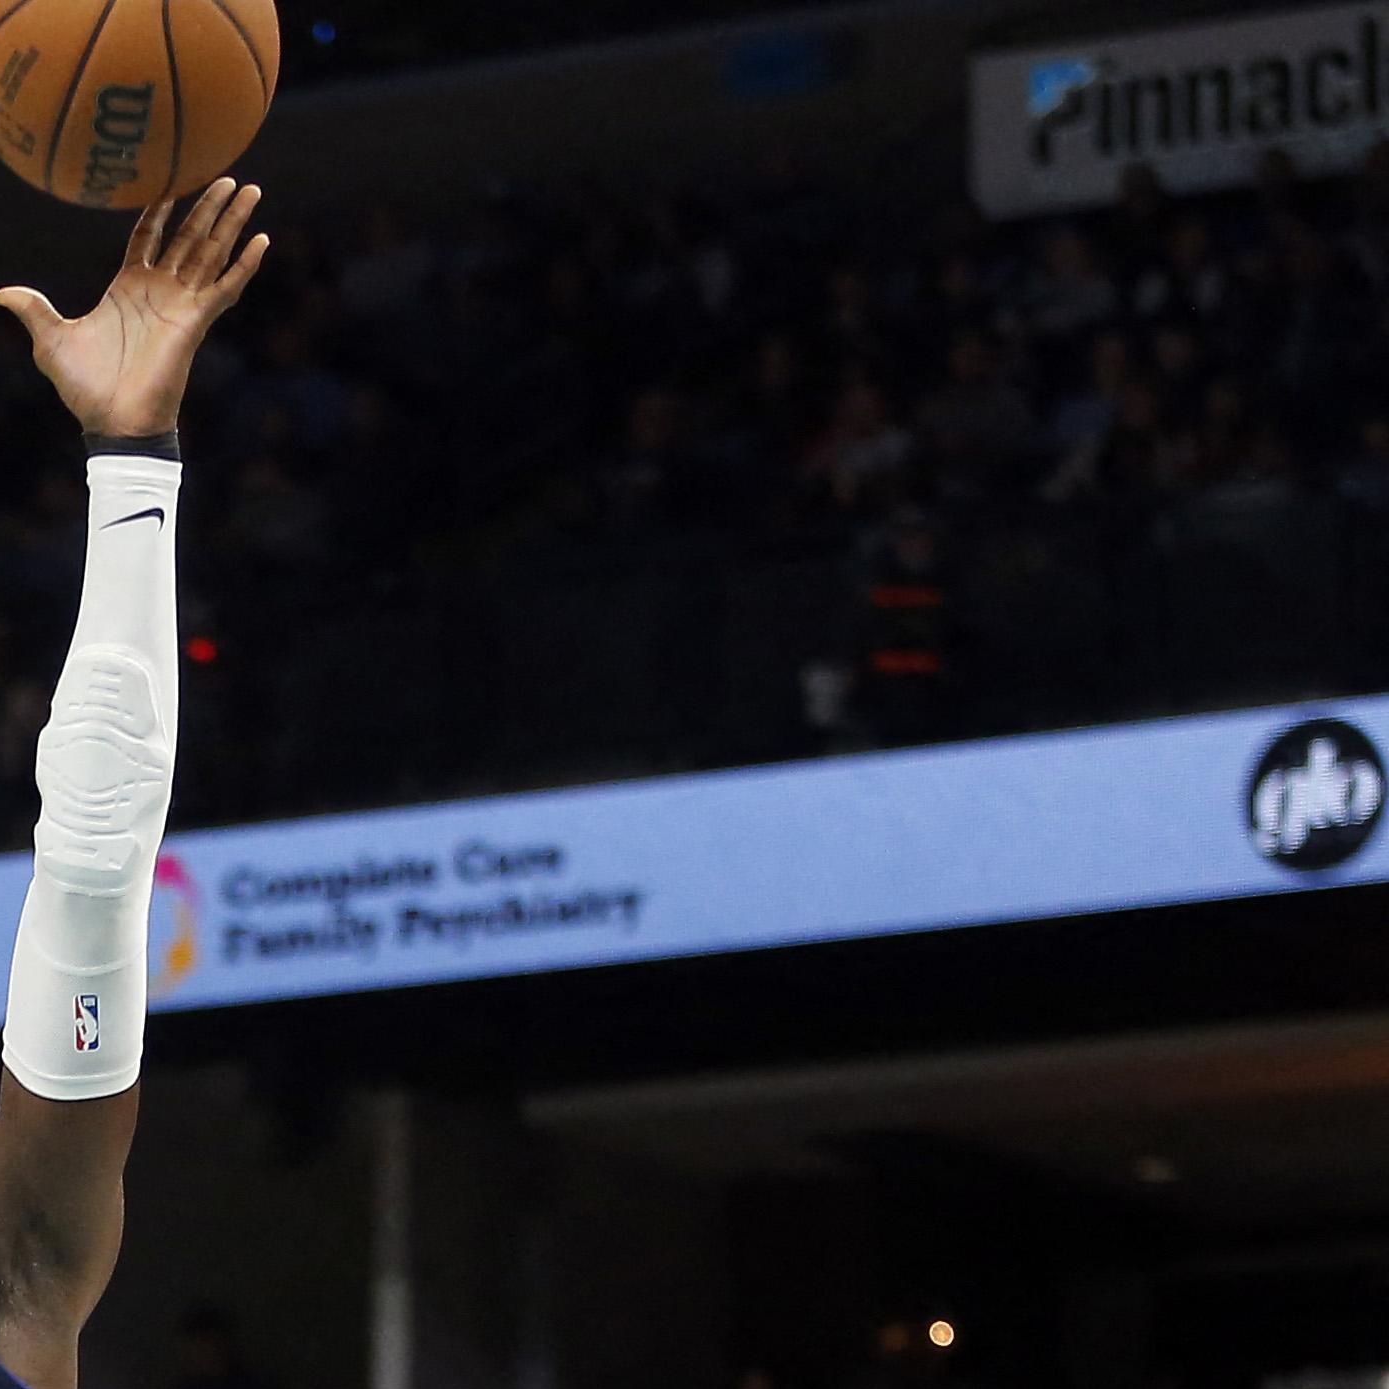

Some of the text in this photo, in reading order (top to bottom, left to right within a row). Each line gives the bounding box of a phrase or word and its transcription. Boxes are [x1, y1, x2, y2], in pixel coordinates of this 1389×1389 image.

[1028, 14, 1379, 166] Pinnacl
[225, 840, 564, 908] Complete Care
[225, 884, 644, 961] Family Psychiatry
